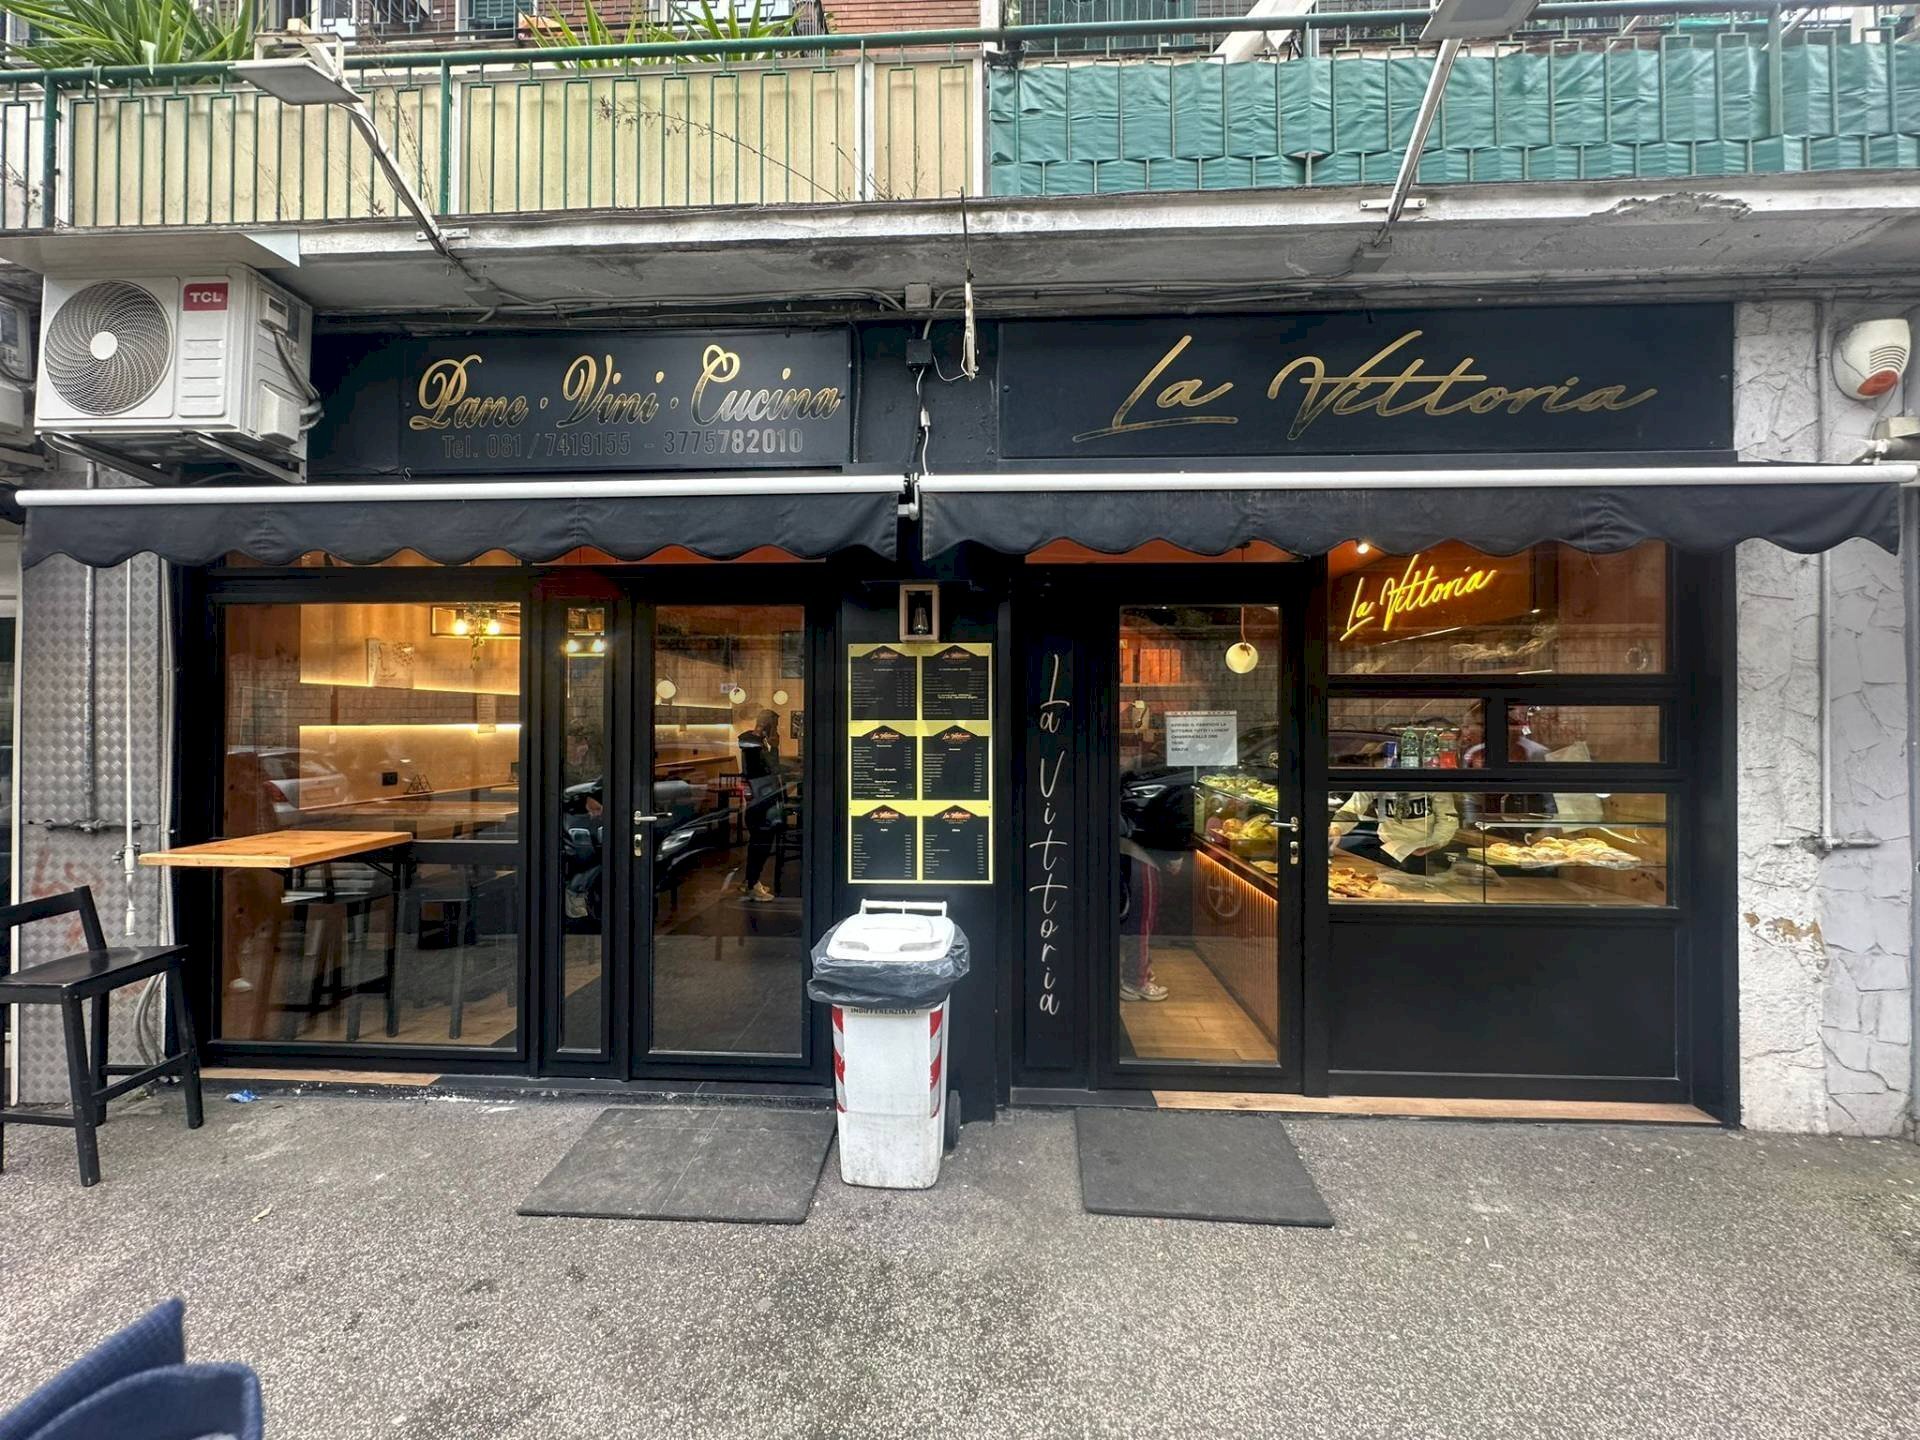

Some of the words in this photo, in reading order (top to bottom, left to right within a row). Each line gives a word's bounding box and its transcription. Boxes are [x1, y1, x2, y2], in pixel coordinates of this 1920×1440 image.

[189, 291, 222, 303] TCL
[409, 354, 530, 430] Pane
[556, 354, 665, 428] Vini
[691, 344, 842, 426] Cucina
[1072, 335, 1239, 443] La
[1267, 330, 1658, 440] Vittoria
[441, 435, 480, 458] Tel.
[663, 429, 804, 455] 3775782010
[1339, 577, 1376, 641] La
[1379, 553, 1498, 632] Vittoria
[1039, 654, 1070, 733] La
[1029, 750, 1068, 1016] Vittoria
